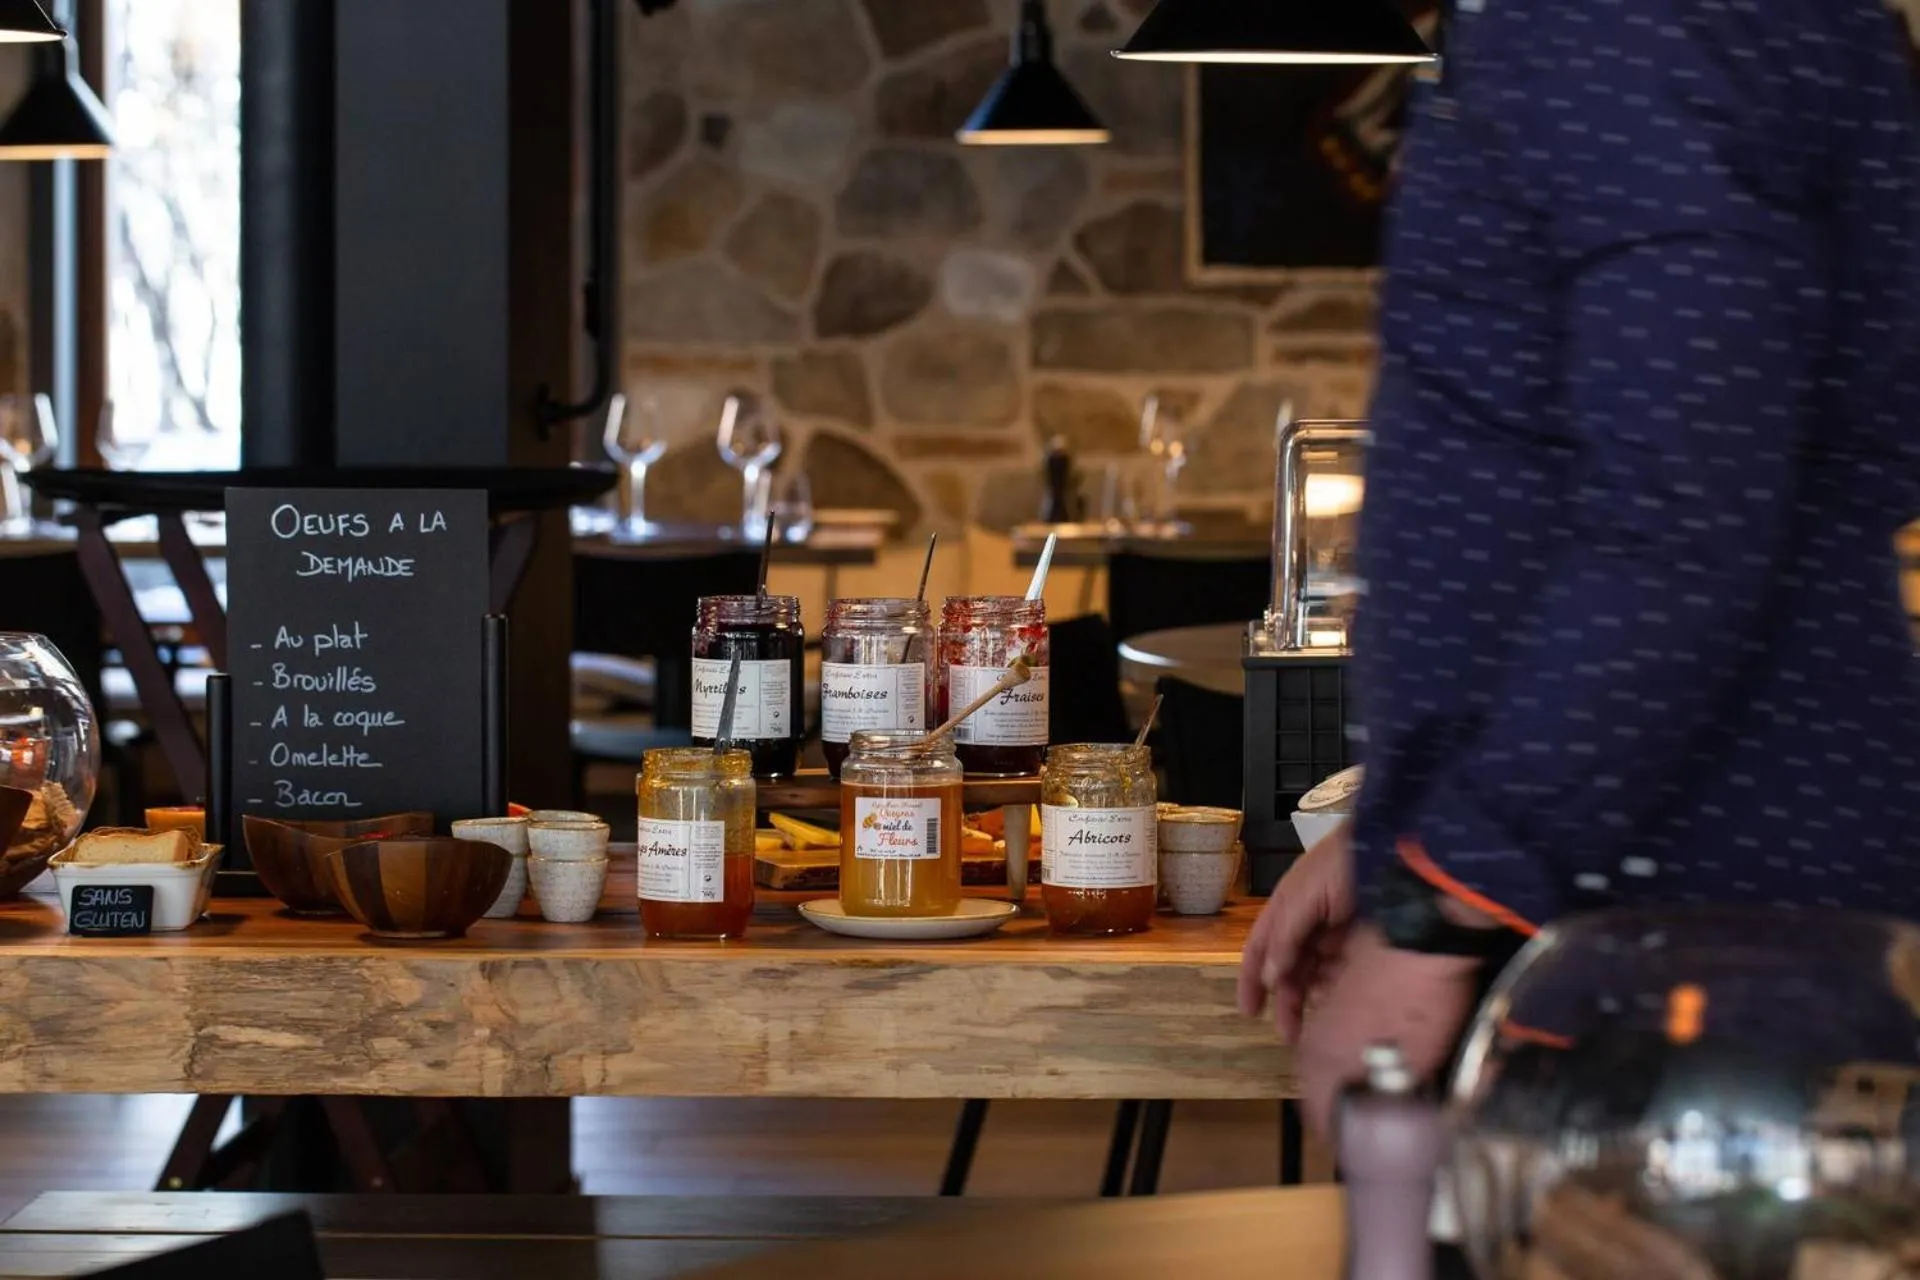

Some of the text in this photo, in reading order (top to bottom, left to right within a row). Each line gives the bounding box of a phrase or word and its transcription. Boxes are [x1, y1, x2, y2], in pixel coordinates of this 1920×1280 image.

[270, 503, 448, 538] OEUFS A LA
[296, 551, 415, 582] DEMANDE
[274, 621, 368, 656] Au plat
[271, 662, 377, 693] Brouillés
[822, 682, 888, 700] Framboises
[271, 704, 405, 736] A la coque
[269, 742, 383, 768] Omelette
[274, 779, 363, 808] Bacon
[647, 840, 688, 858] Amères
[877, 831, 920, 847] Fleurs
[1068, 828, 1133, 847] Abricots
[78, 888, 133, 906] SANS
[73, 909, 146, 929] GLUTEN
